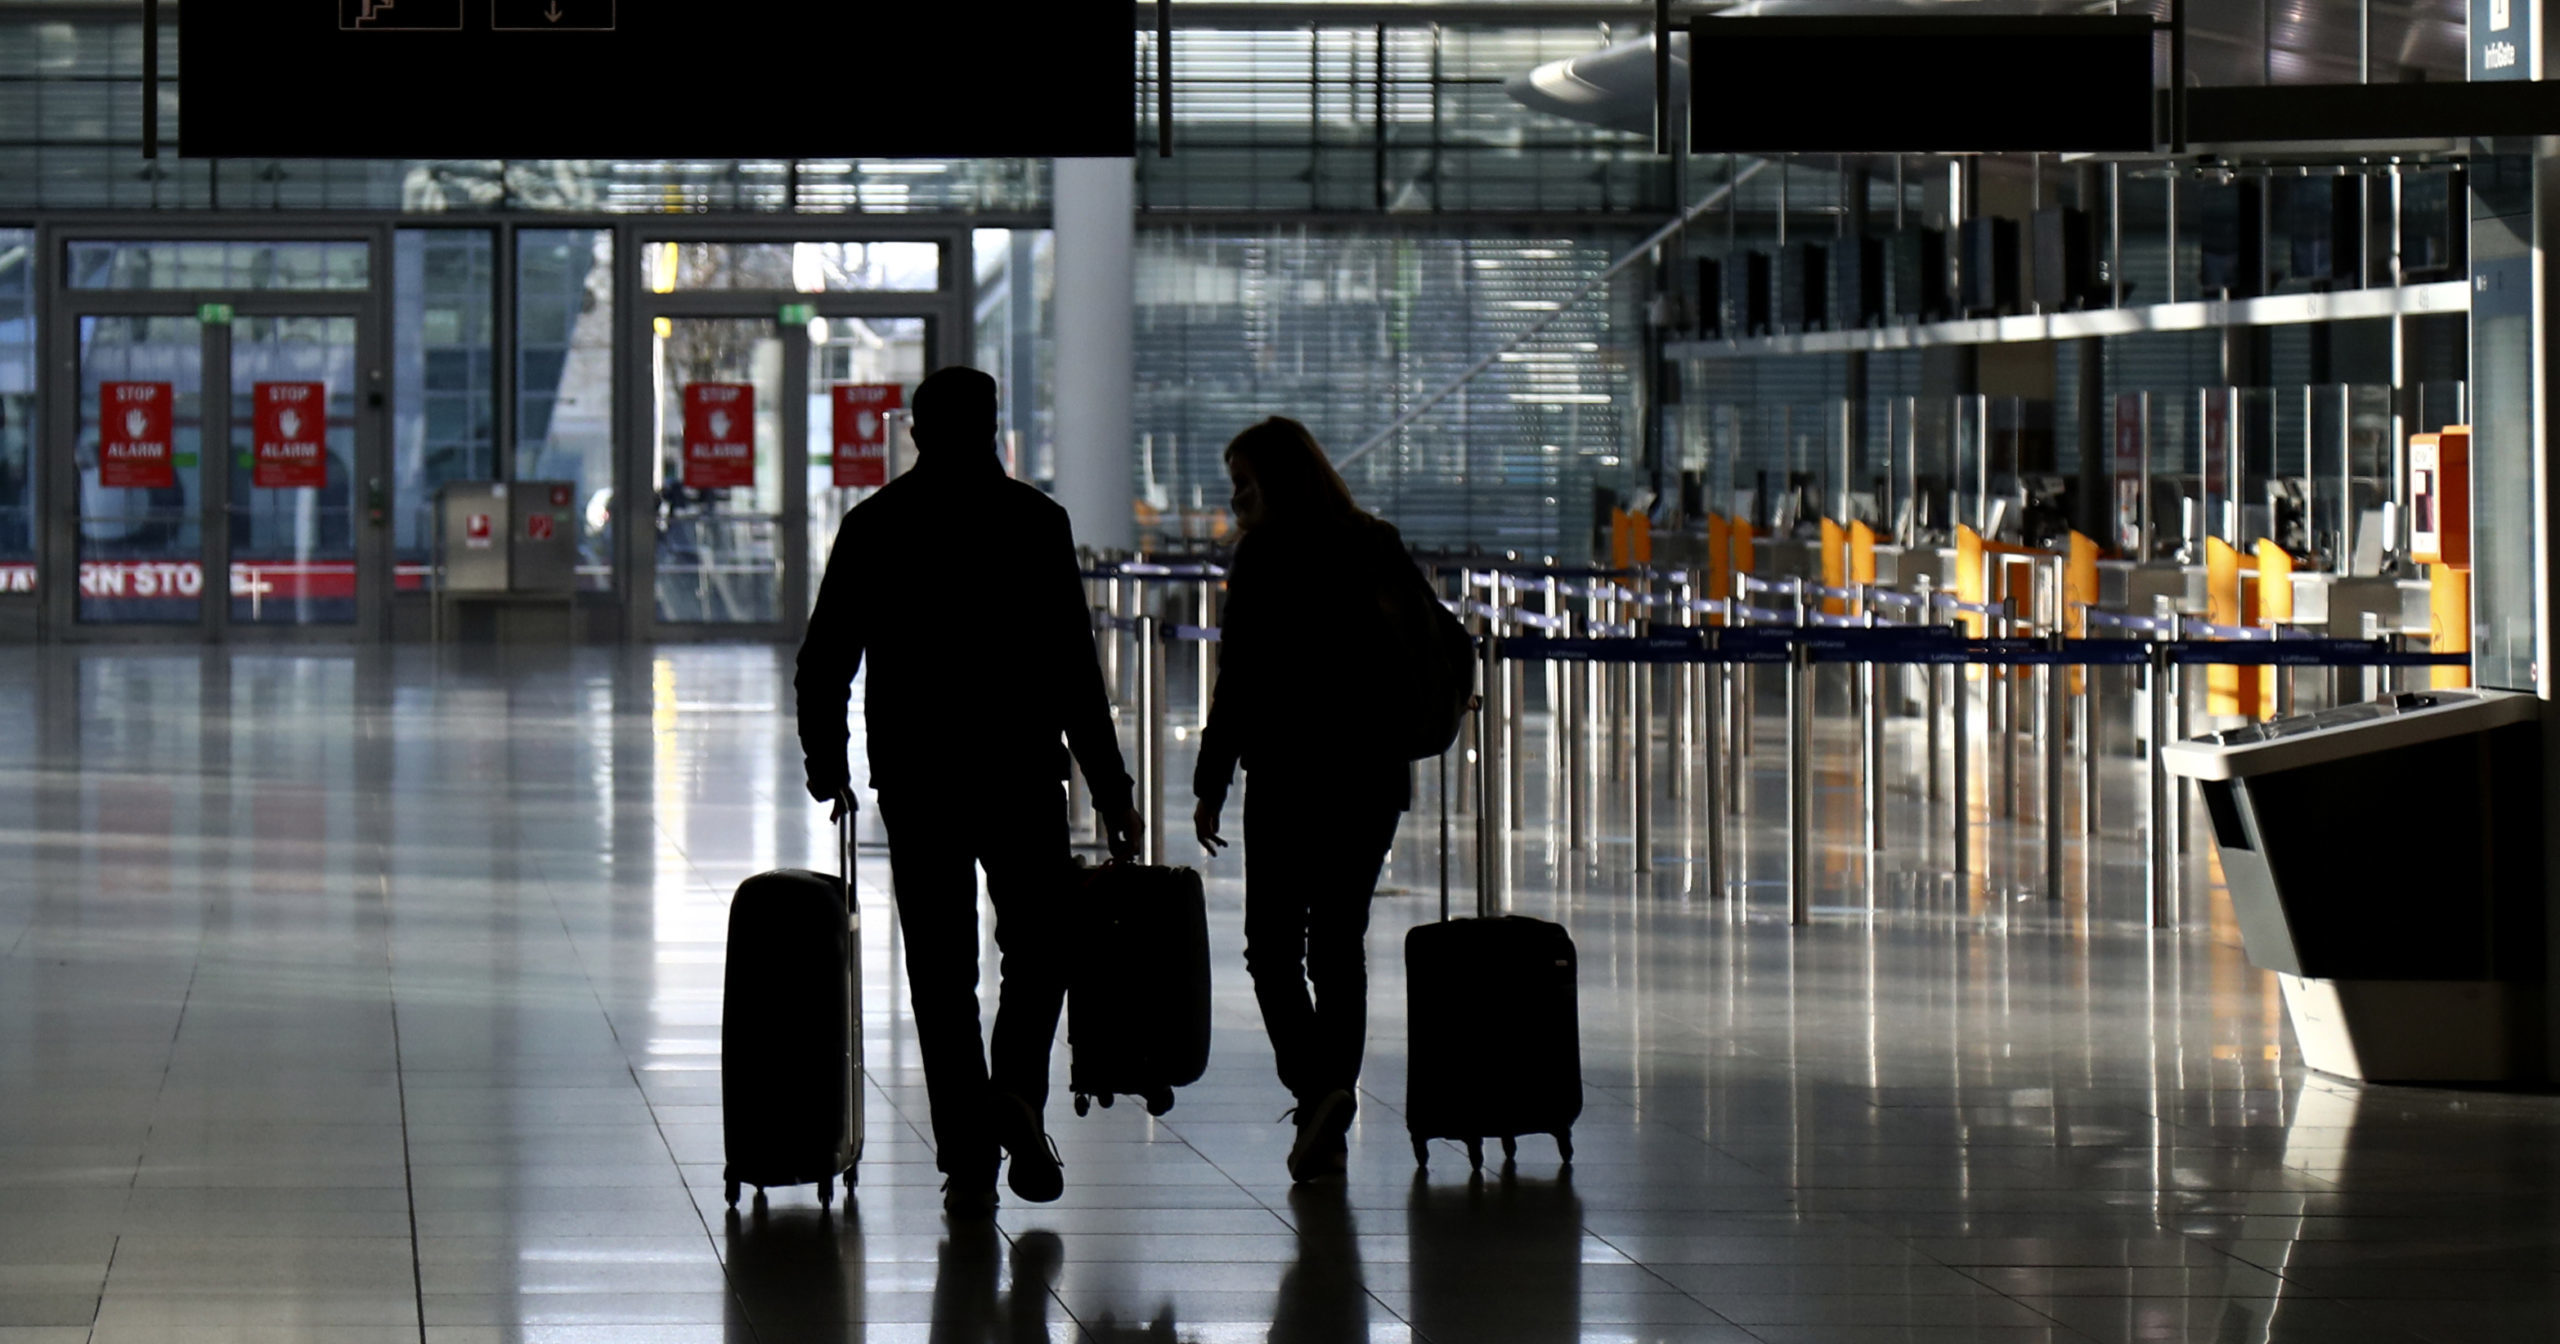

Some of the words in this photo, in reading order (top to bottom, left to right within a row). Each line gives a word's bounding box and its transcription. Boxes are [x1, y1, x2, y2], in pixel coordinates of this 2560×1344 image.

[2484, 41, 2515, 70] InfoGate
[116, 386, 156, 402] STOP
[269, 386, 310, 402] STOP
[698, 387, 740, 403] STOP
[846, 387, 887, 403] STOP
[107, 442, 165, 457] ALARM
[260, 442, 318, 457] ALARM
[691, 443, 748, 458] ALARM
[839, 443, 884, 458] ALAR
[1930, 653, 1970, 662] Lufthansa
